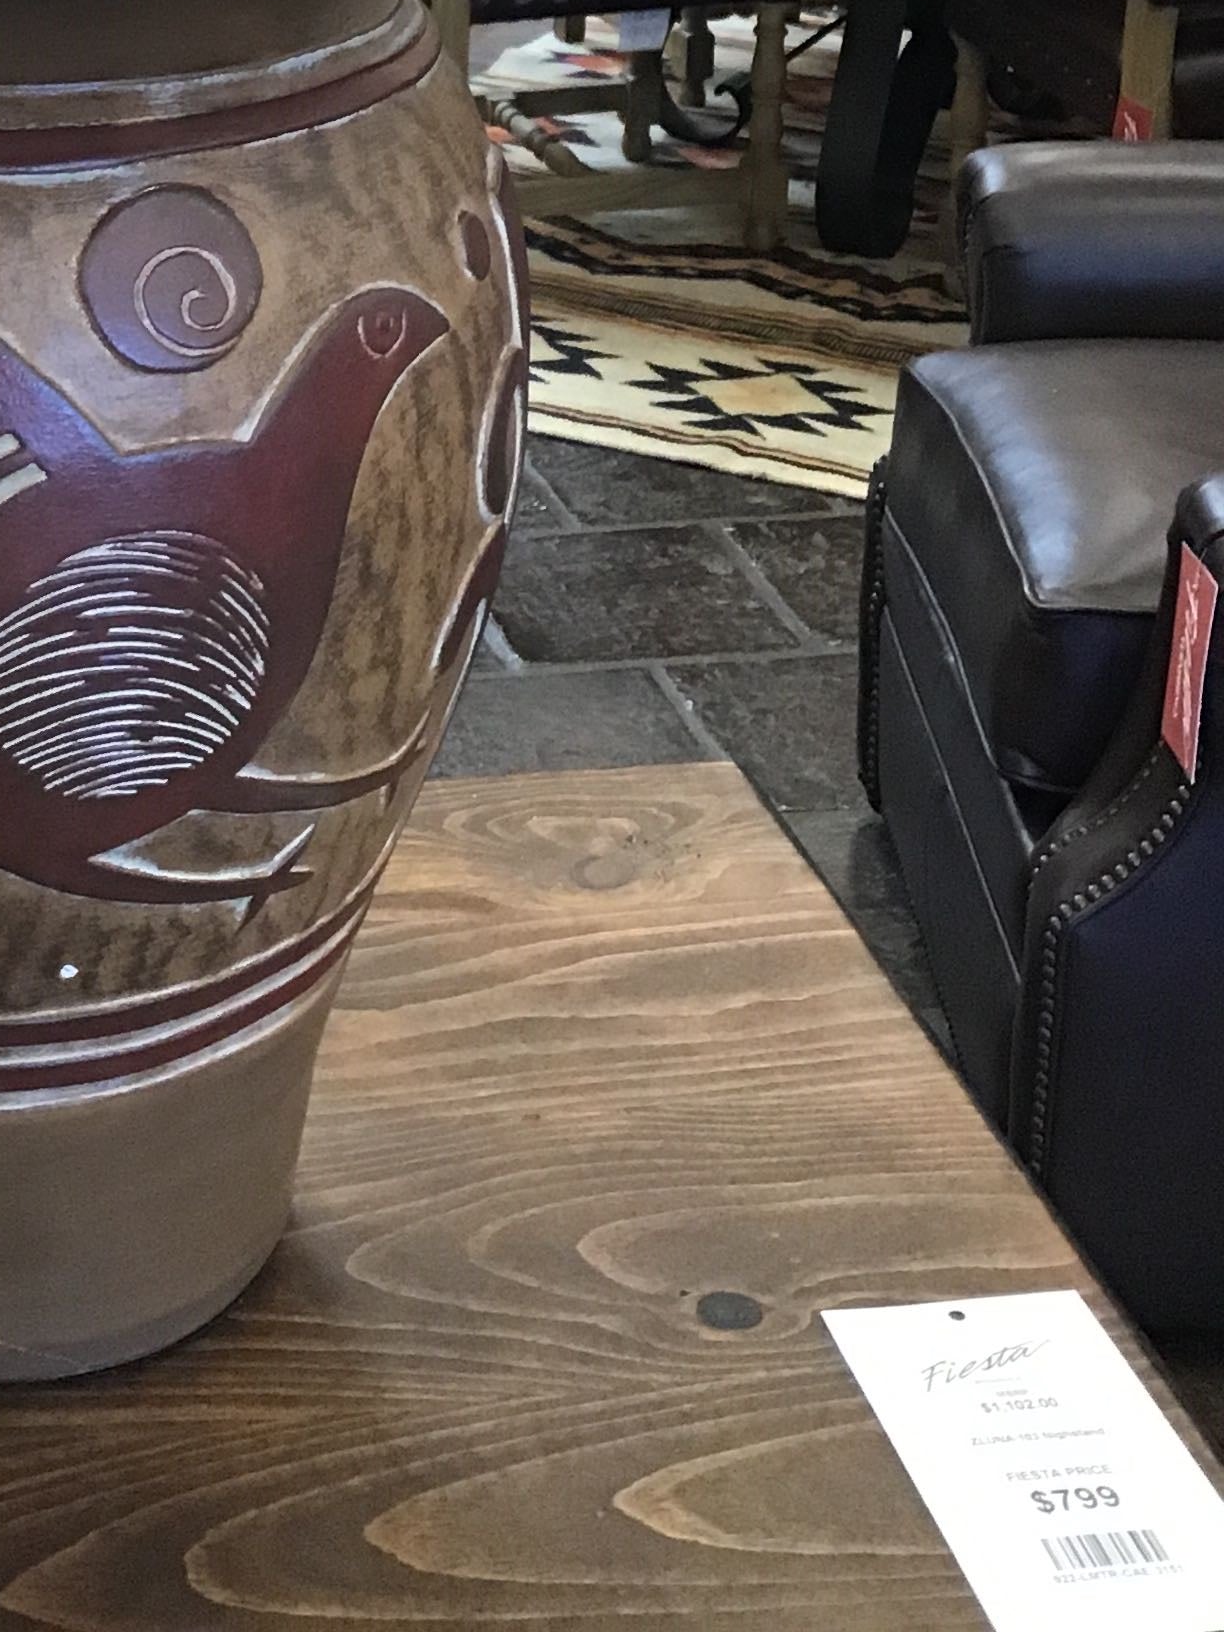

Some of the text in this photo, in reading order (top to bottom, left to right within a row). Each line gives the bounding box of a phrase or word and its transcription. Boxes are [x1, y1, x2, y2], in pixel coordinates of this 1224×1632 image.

[921, 1339, 1051, 1393] Fiesta
[1006, 1464, 1113, 1482] FIESTA PRICE
[1030, 1485, 1121, 1515] $799
